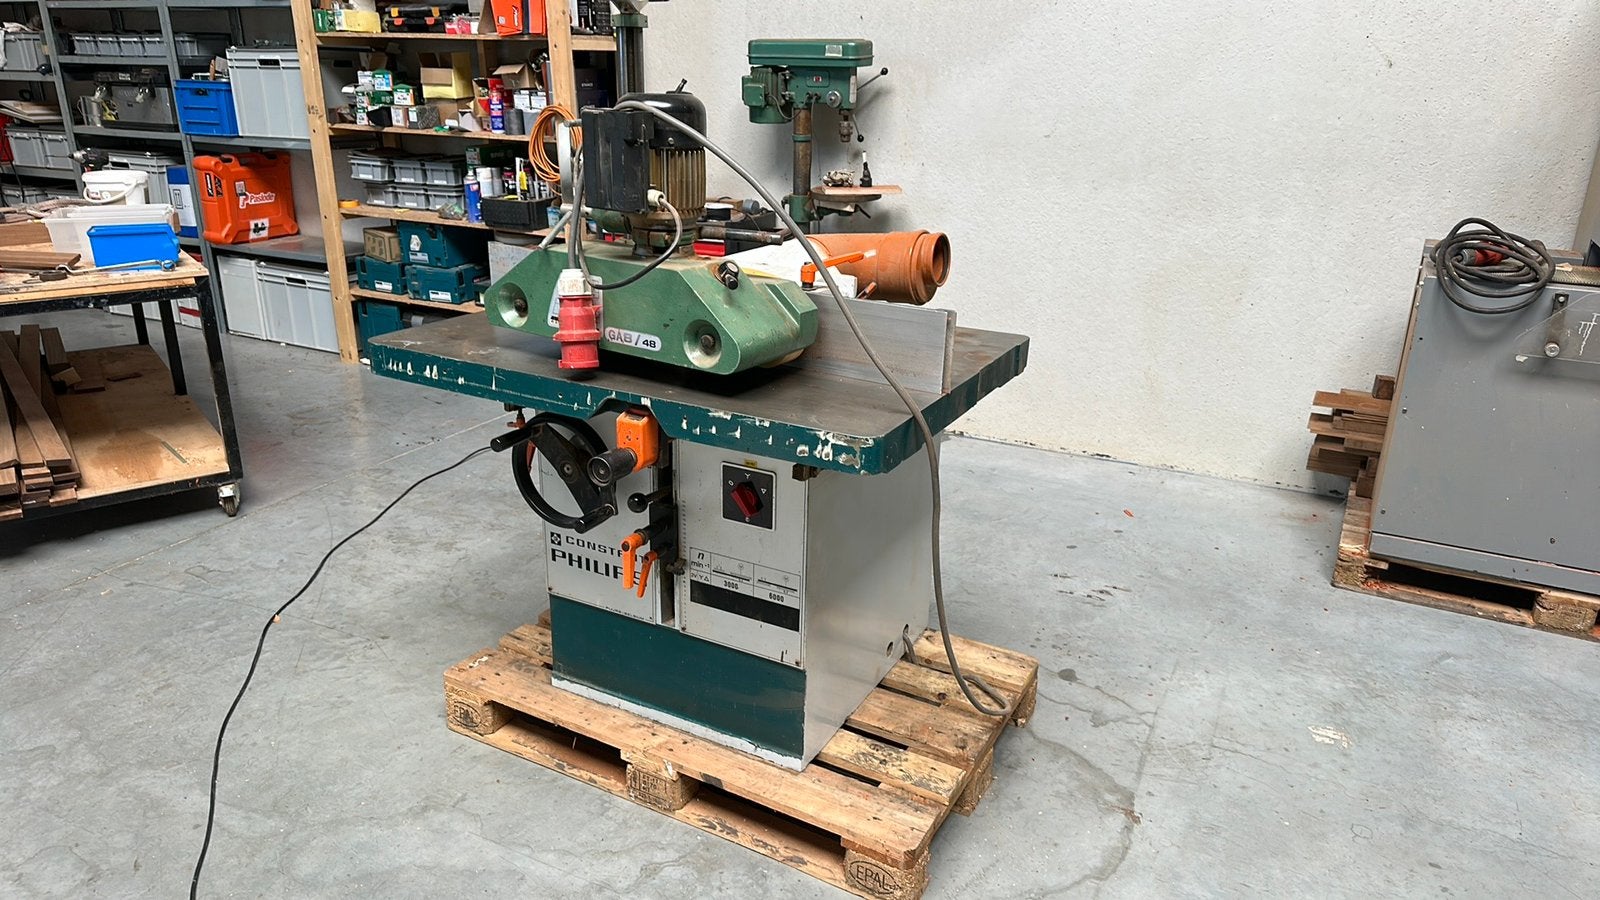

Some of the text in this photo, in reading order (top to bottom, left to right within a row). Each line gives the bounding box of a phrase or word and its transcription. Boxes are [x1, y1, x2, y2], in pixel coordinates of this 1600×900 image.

[250, 193, 275, 203] Paslode
[642, 339, 657, 348] 48
[566, 535, 645, 564] CONSTRT
[723, 580, 739, 590] 3000
[768, 592, 785, 603] 6000
[856, 864, 890, 891] EPAL
